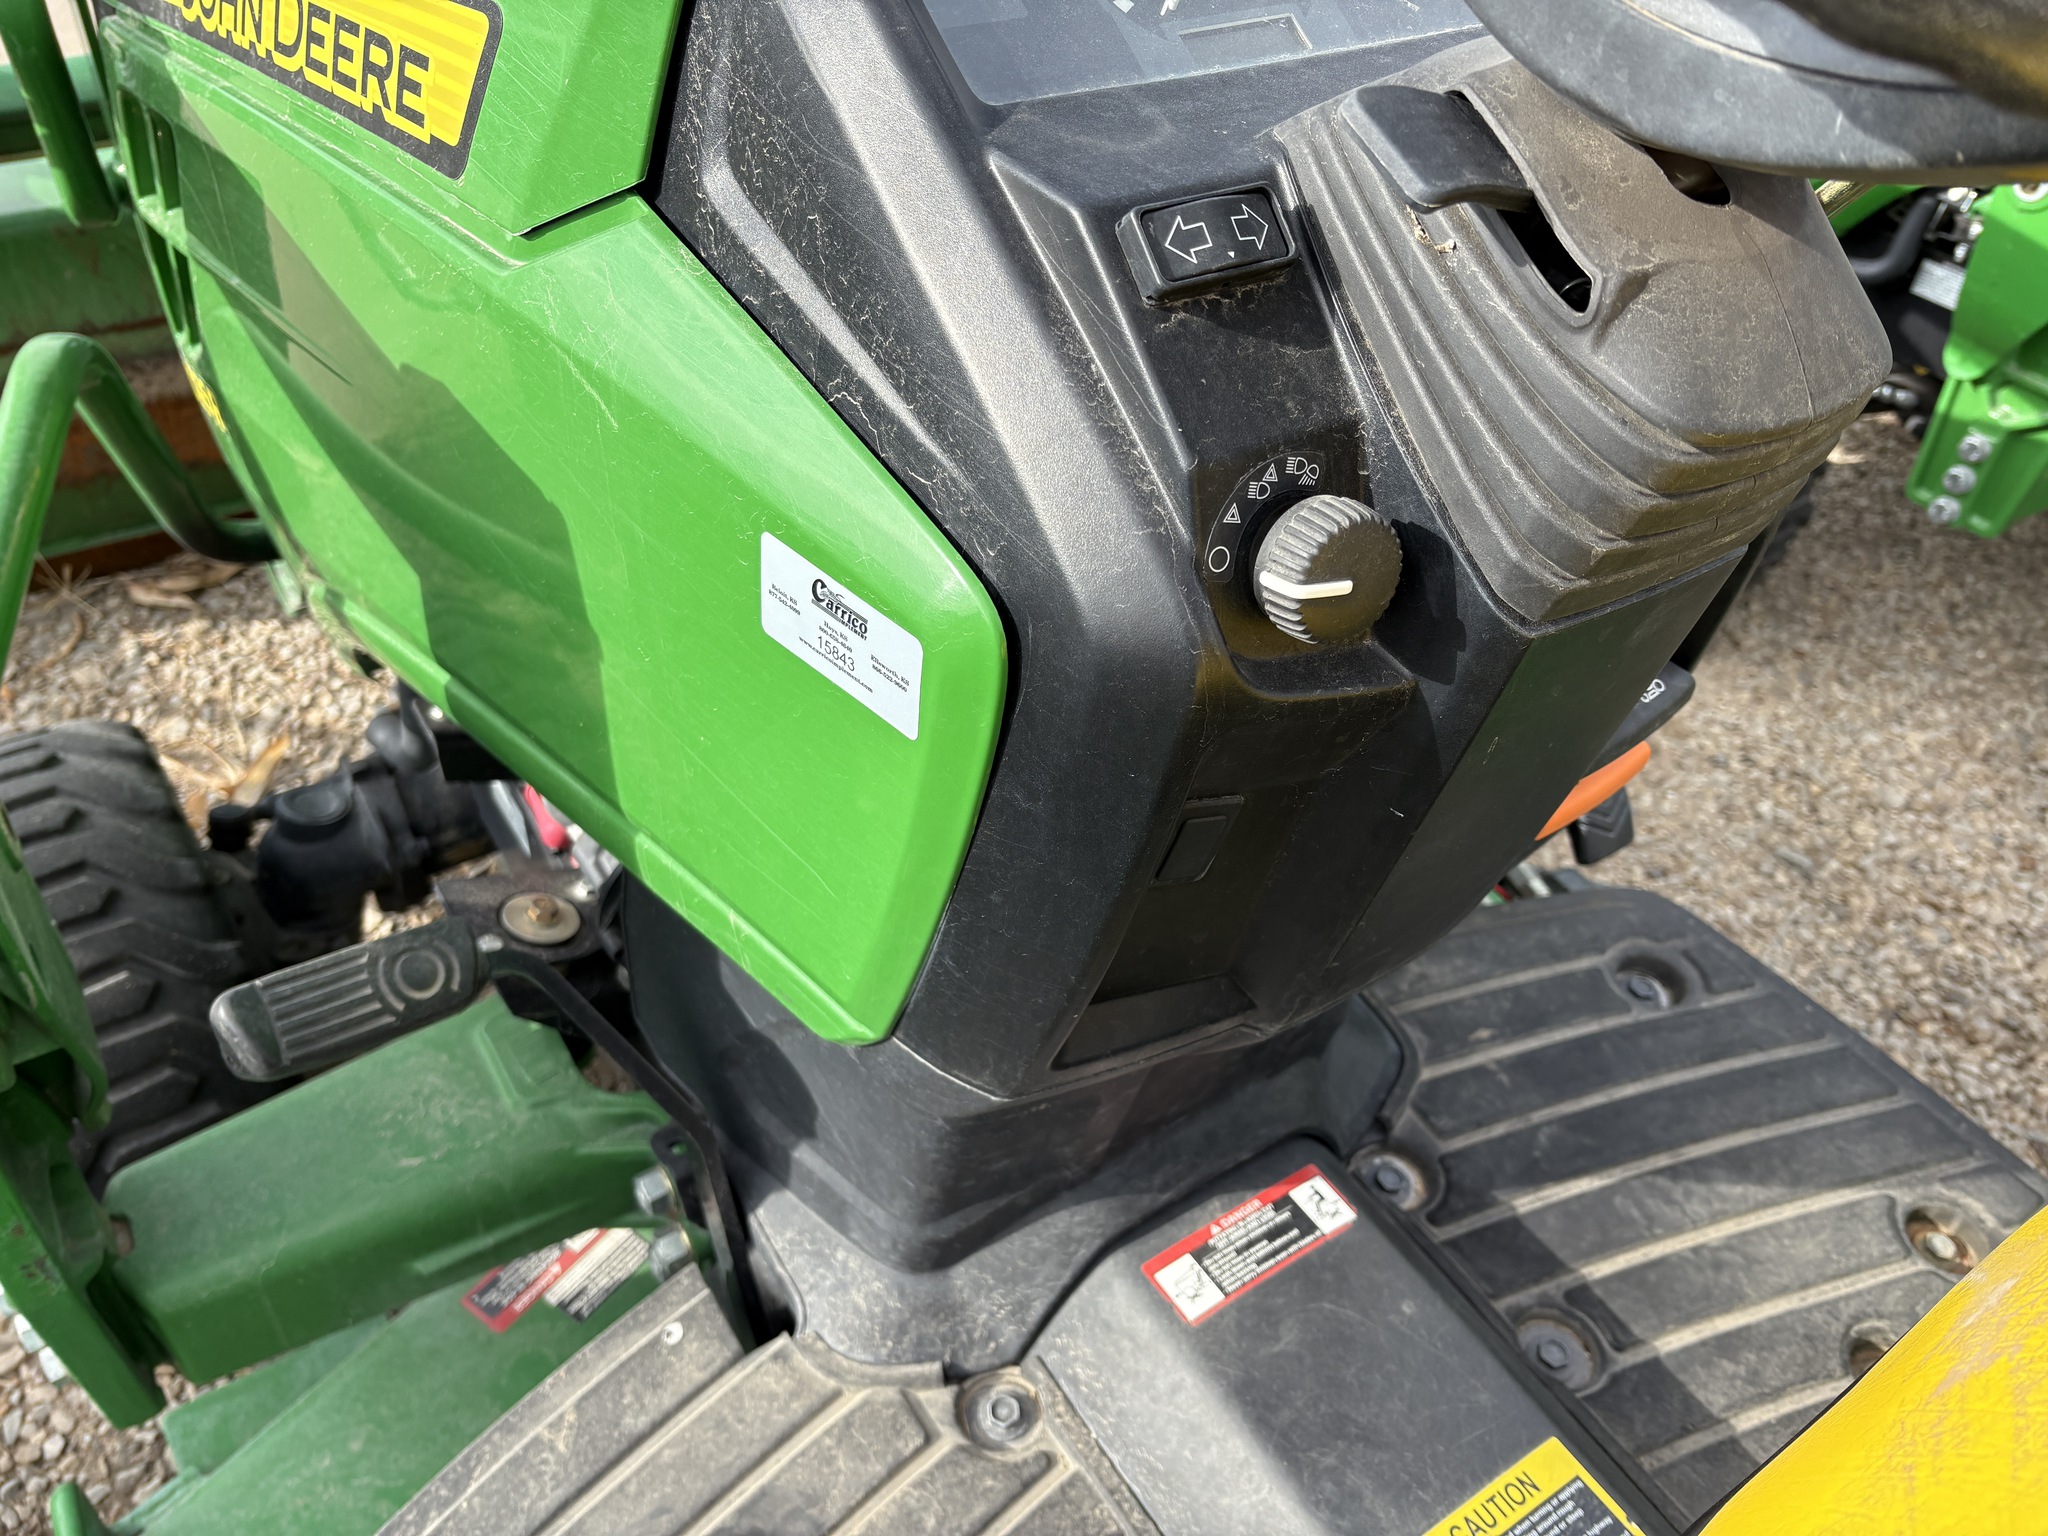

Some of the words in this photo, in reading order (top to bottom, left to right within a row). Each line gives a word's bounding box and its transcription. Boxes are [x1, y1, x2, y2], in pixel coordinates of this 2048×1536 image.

[182, 0, 261, 45] HN
[274, 0, 430, 129] DEERE
[812, 579, 868, 634] Carrico
[817, 635, 855, 672] 15843
[1219, 1198, 1264, 1229] DANGER
